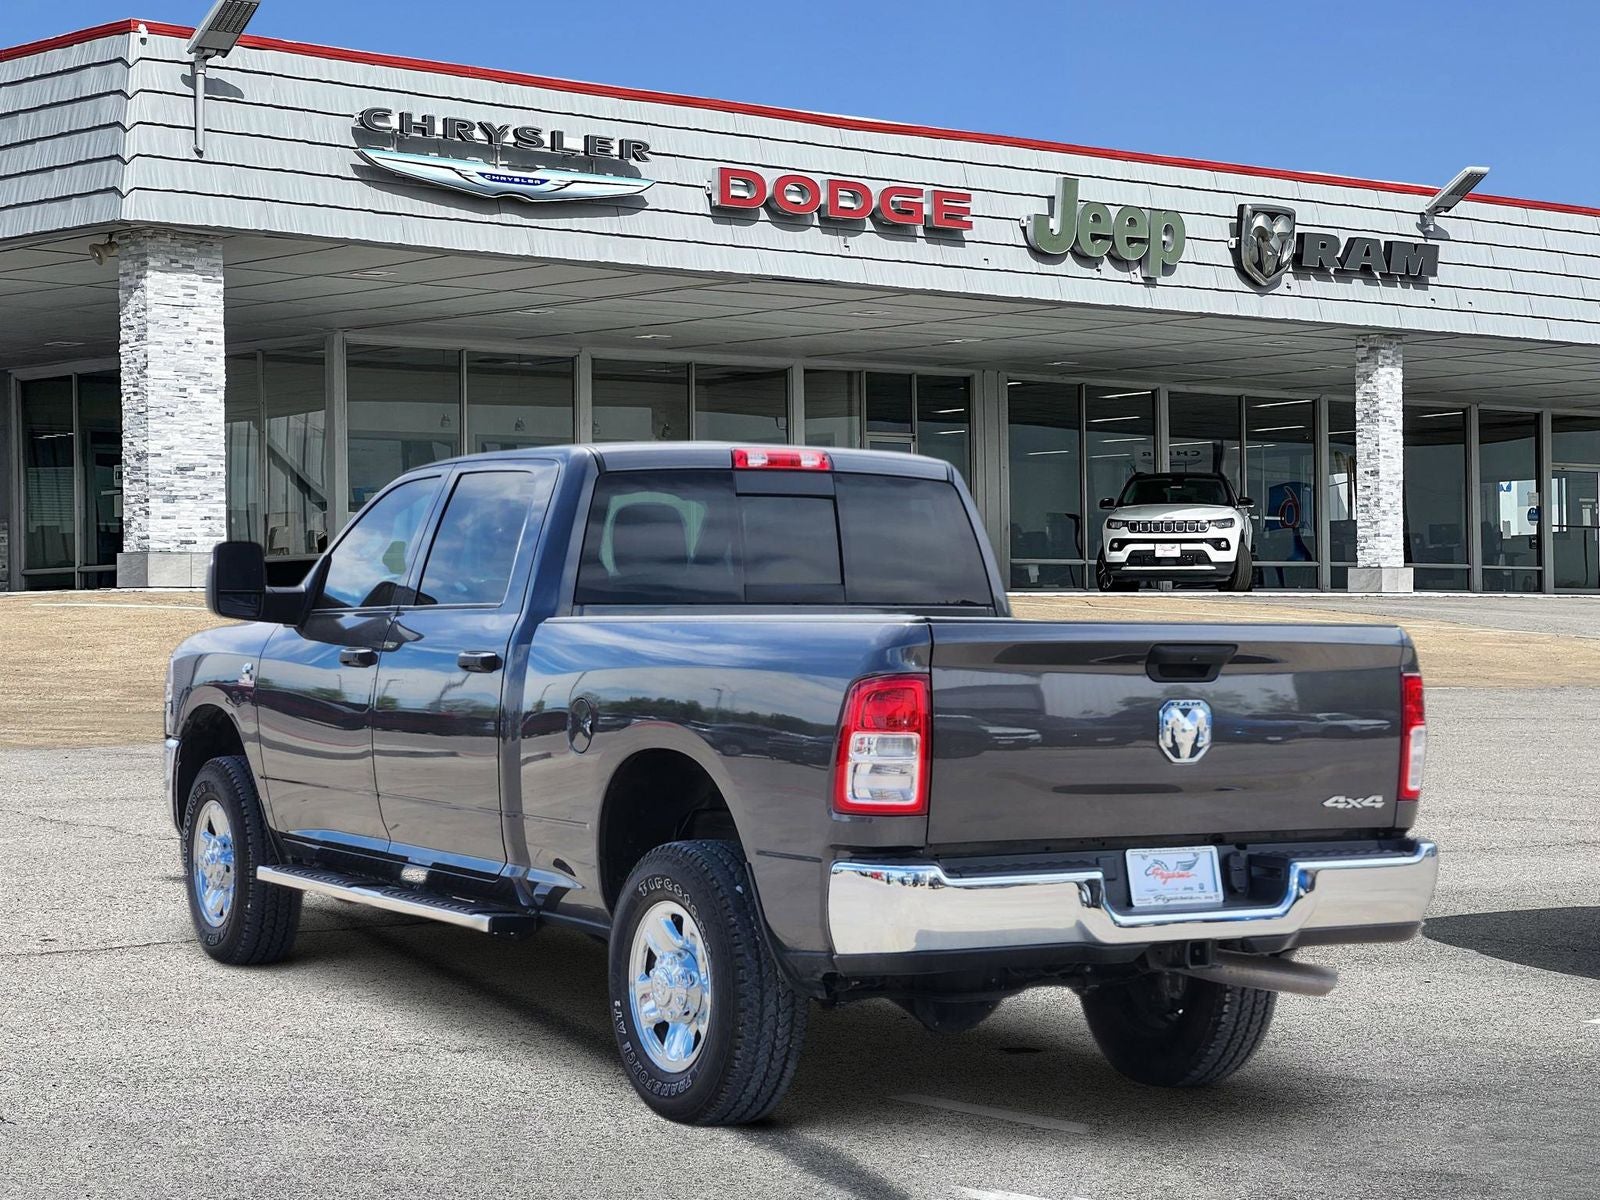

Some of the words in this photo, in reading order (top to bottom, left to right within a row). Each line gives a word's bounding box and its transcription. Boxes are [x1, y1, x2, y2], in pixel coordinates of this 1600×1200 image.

[358, 107, 651, 162] CHRYSLER
[484, 173, 542, 185] CHRYSLER
[711, 166, 974, 231] DODGE
[1027, 177, 1187, 278] Jeep
[1296, 231, 1440, 278] RAM
[1322, 795, 1385, 809] 4x4
